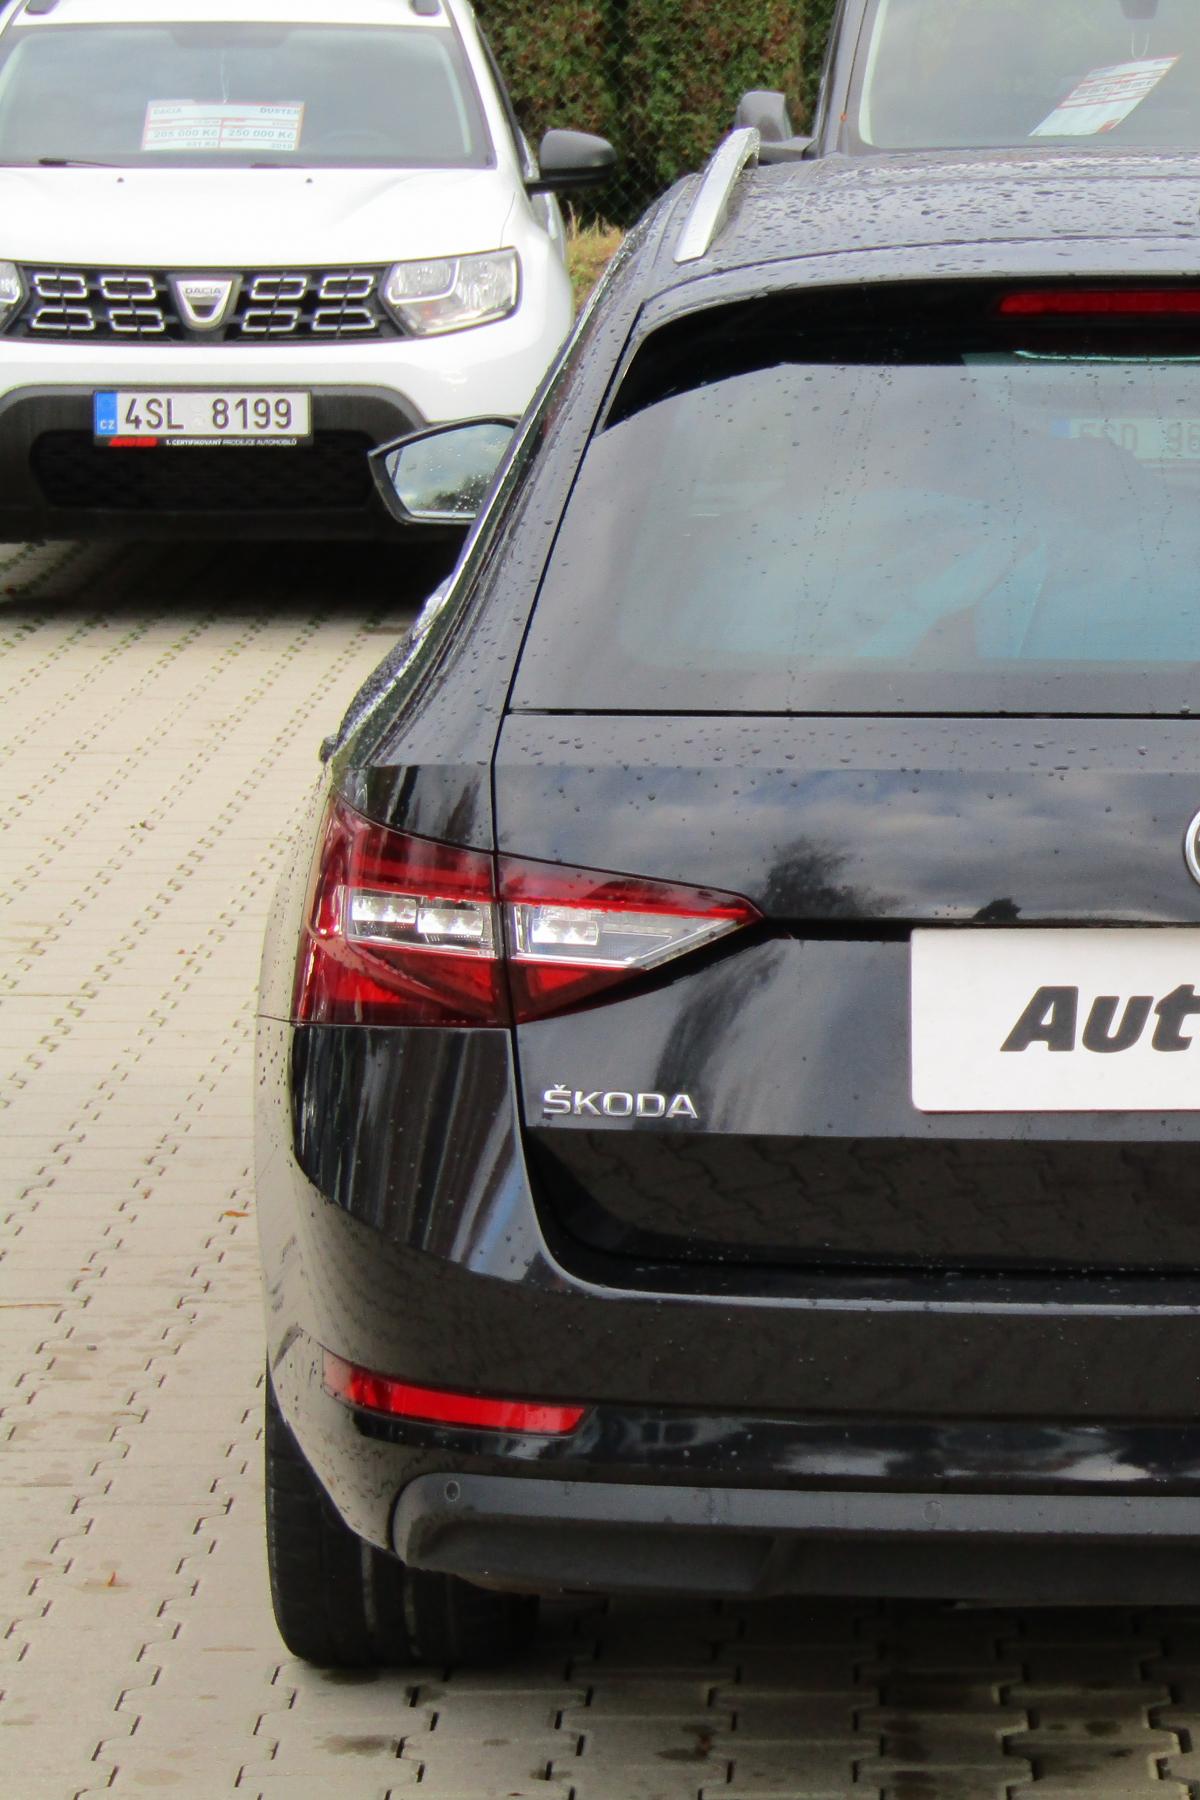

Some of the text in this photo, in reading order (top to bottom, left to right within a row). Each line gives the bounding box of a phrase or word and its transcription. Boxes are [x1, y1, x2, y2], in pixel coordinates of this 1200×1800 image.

[185, 287, 221, 295] DACIA
[100, 398, 293, 430] CZ 4SL 8199
[543, 1084, 698, 1119] ŠKODA
